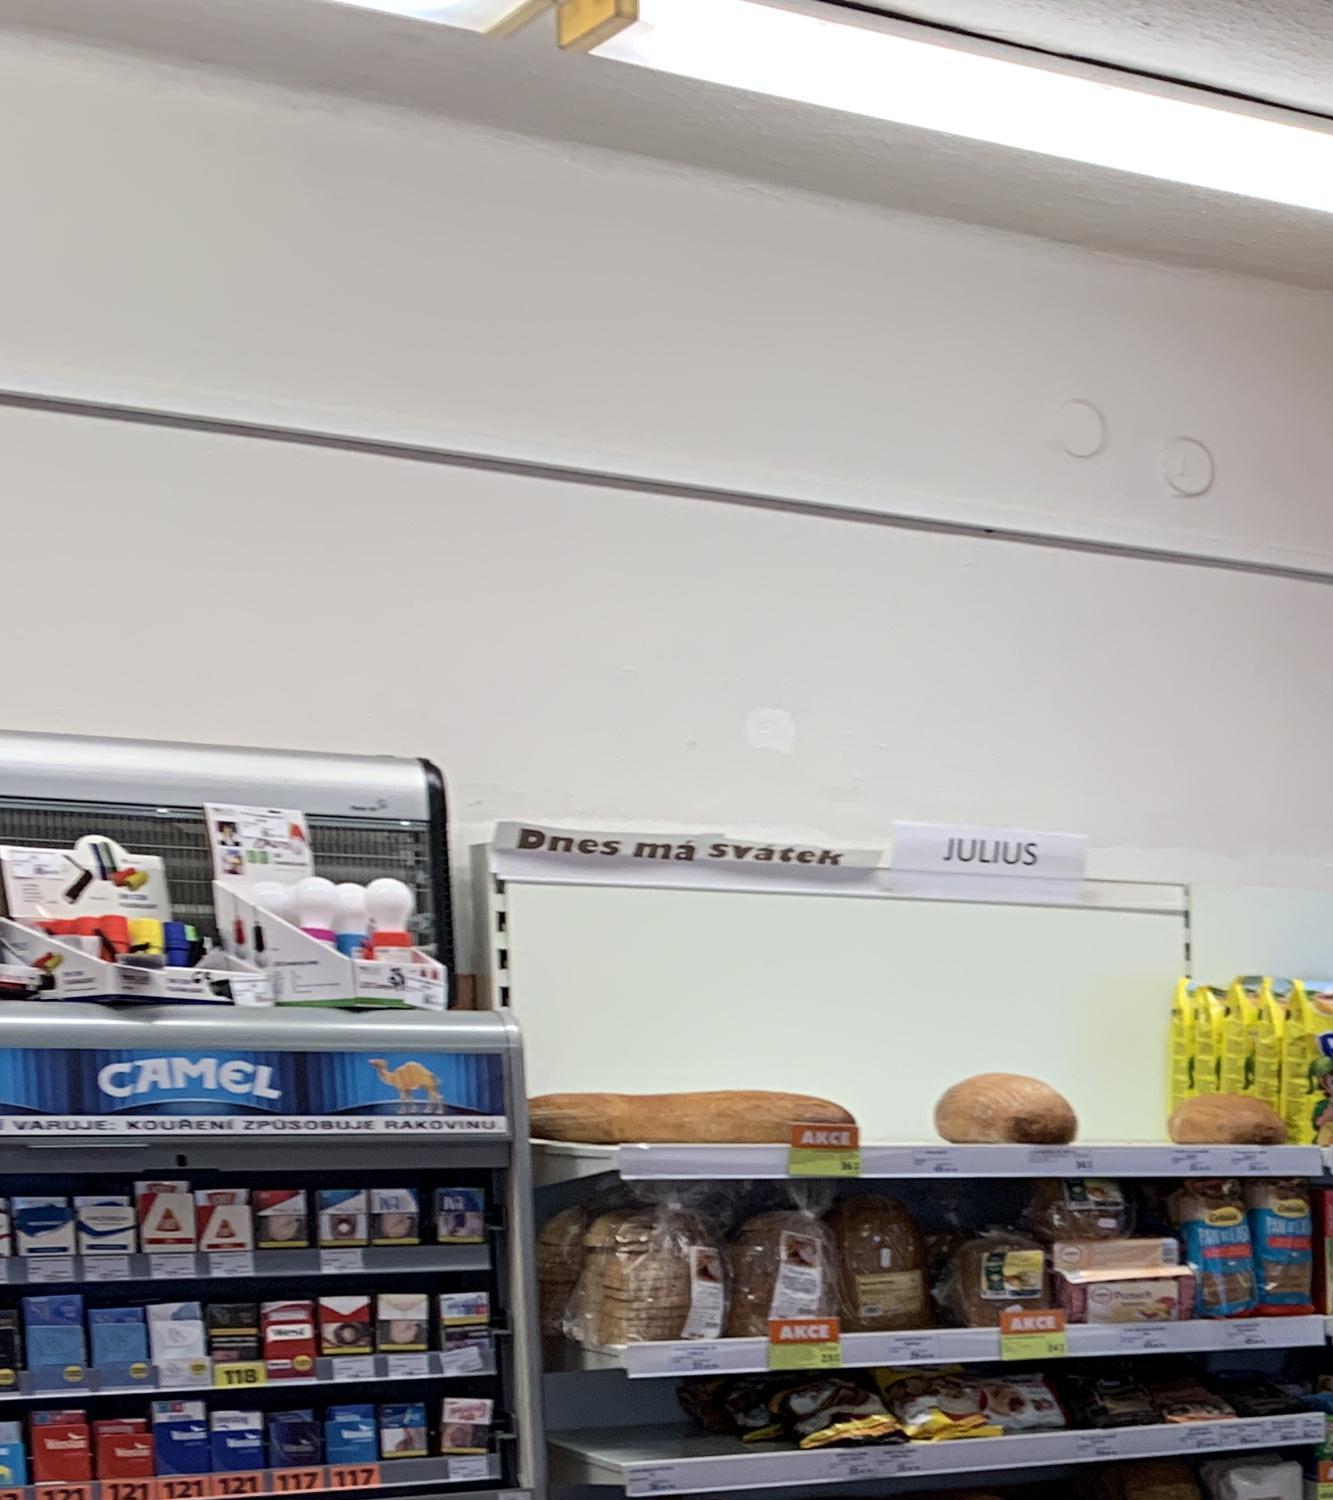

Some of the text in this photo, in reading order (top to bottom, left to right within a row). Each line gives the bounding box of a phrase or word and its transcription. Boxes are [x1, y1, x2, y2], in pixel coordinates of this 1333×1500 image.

[518, 828, 844, 867] Dnes má svátek
[942, 838, 1038, 868] JULIUS
[97, 1057, 283, 1099] CAMEL
[13, 1118, 117, 1132] VARUJE:
[126, 1117, 233, 1132] KOUŘENÍ
[242, 1117, 375, 1132] ZPŮSOBUJE
[801, 1129, 851, 1147] AKCE
[779, 1323, 831, 1341] AKCE
[1010, 1315, 1058, 1333] AKCE
[224, 1368, 257, 1385] 118
[219, 1476, 258, 1495] 121
[277, 1472, 319, 1491] 117
[333, 1469, 375, 1488] 117
[162, 1480, 202, 1499] 121
